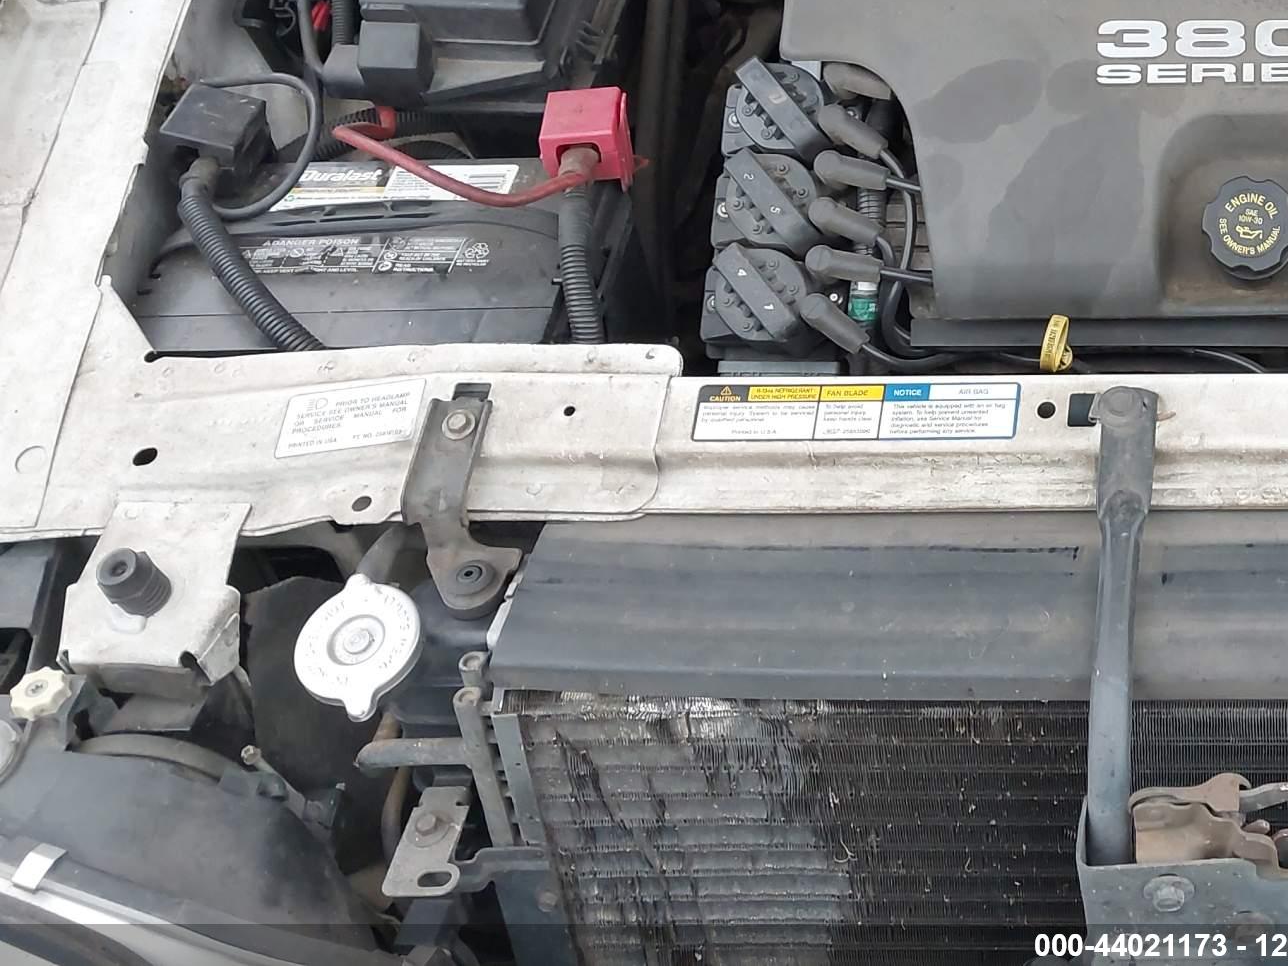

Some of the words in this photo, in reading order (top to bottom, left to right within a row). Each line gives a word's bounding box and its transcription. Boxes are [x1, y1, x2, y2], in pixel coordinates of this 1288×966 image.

[301, 168, 386, 183] Duralast
[770, 206, 781, 214] 5
[1224, 193, 1266, 213] ENGINE
[1264, 201, 1279, 220] OIL
[1244, 208, 1258, 216] SAE
[1219, 218, 1229, 235] SEE
[1239, 214, 1263, 225] 10W-30
[1223, 234, 1256, 255] OWNER'S
[1256, 225, 1281, 253] MANUAL
[737, 268, 748, 277] 4
[335, 399, 358, 407] PRIOR
[371, 392, 411, 403] HEADLAMP
[296, 410, 326, 419] SERVICE
[329, 408, 342, 416] SEE
[379, 400, 408, 408] MANUAL
[314, 416, 344, 424] SERVICE
[288, 440, 315, 449] PRINTED
